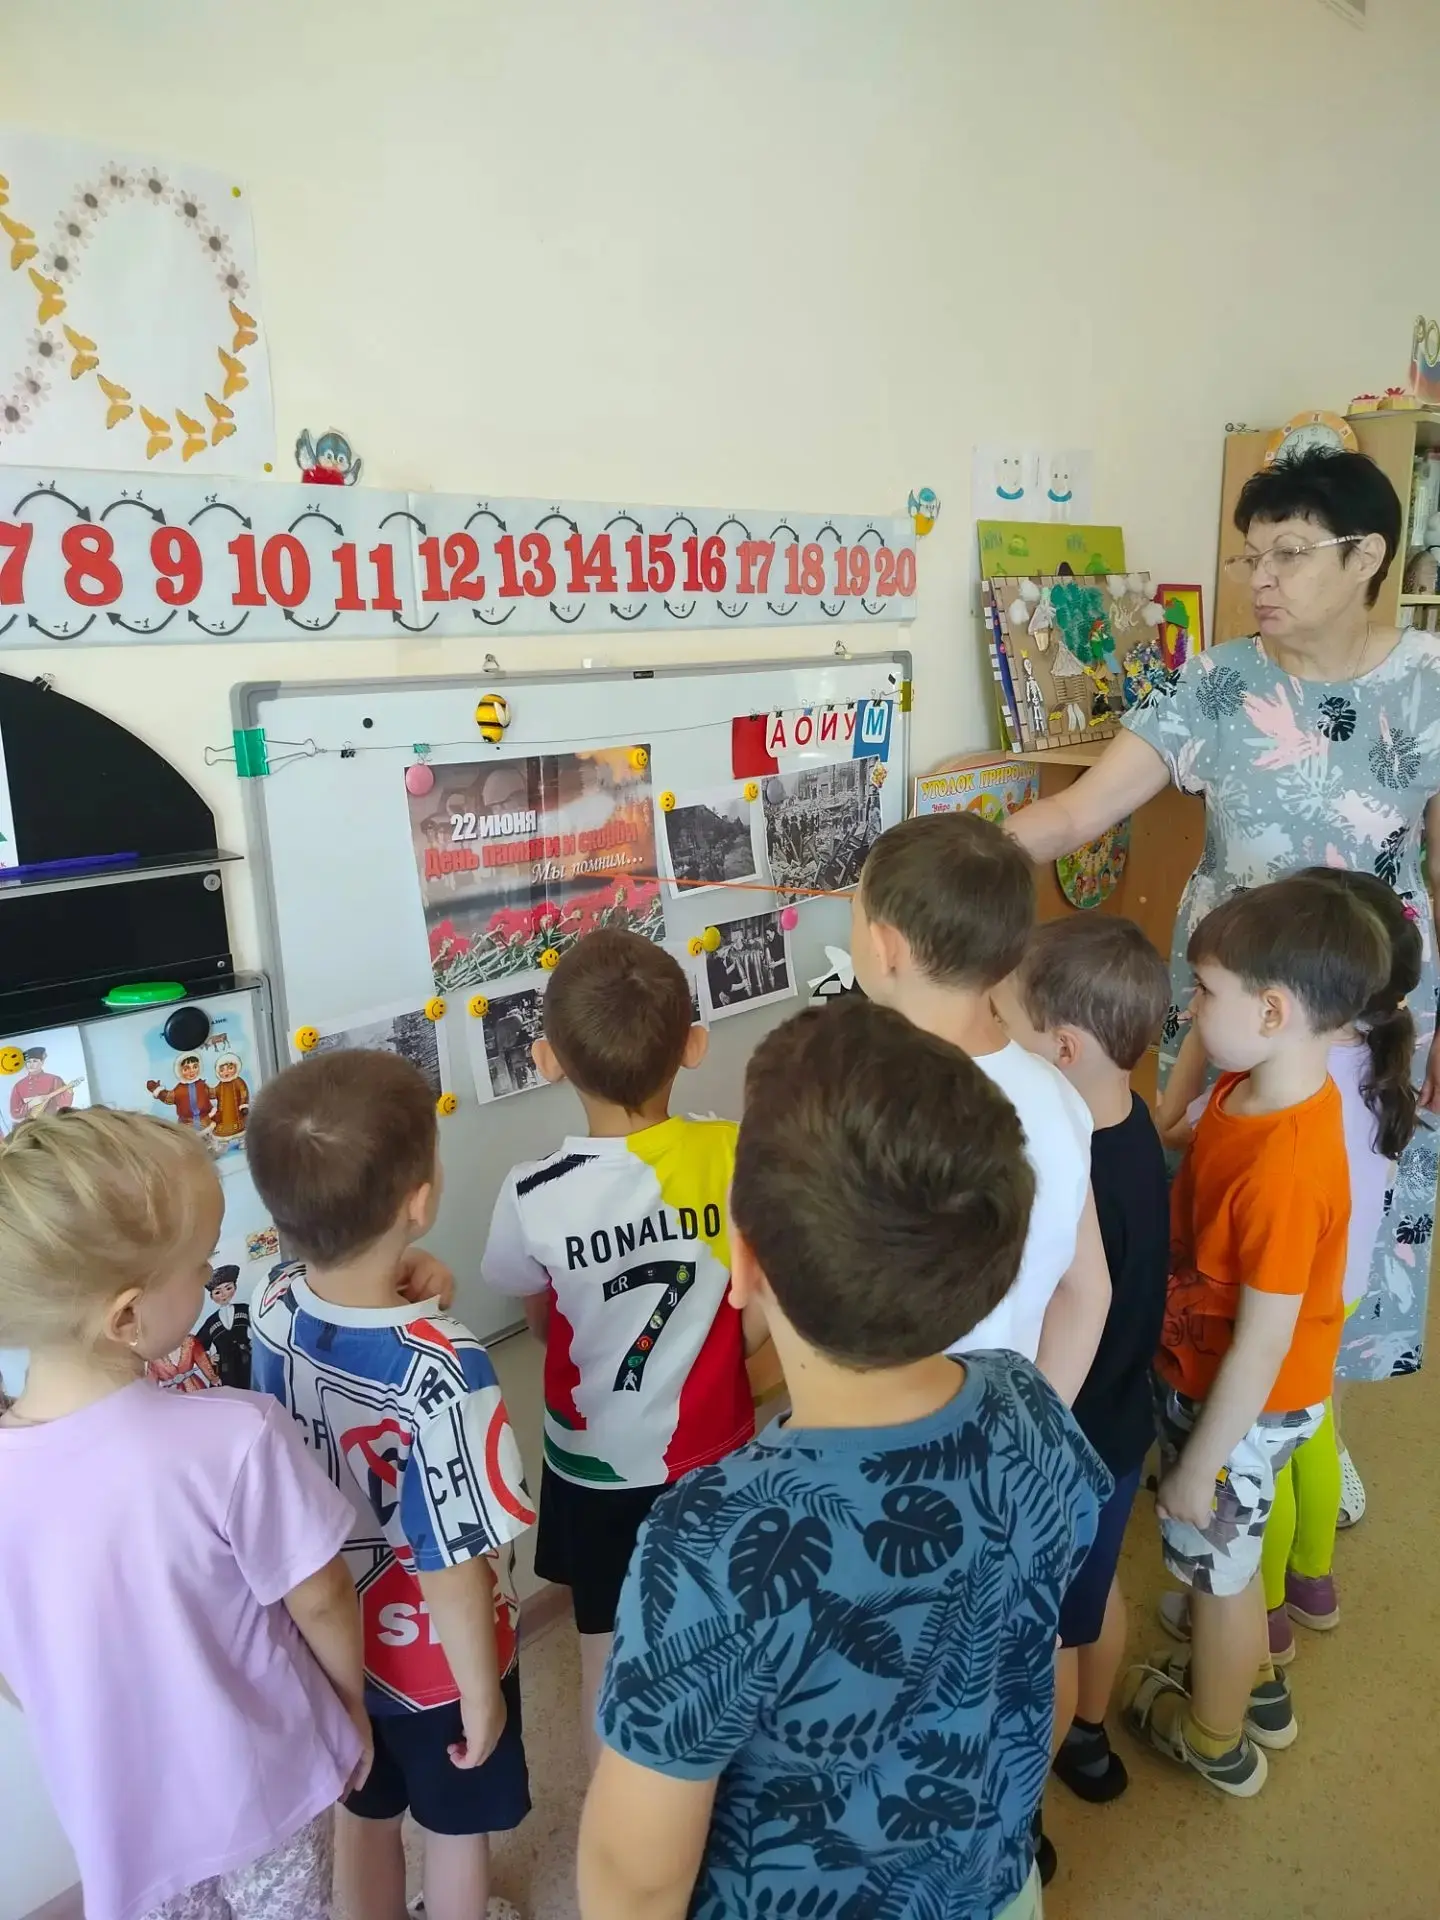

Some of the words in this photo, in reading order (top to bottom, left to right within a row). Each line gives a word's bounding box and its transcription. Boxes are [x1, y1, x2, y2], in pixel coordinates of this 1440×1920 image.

[0, 521, 33, 605] 7
[61, 523, 123, 606] 8
[150, 526, 203, 606] 9
[228, 533, 310, 608] 10
[332, 543, 402, 612] 11
[418, 532, 485, 602] 12
[494, 533, 556, 597] 13
[564, 533, 618, 593] 14
[624, 533, 675, 593] 15
[682, 535, 726, 593] 16
[736, 540, 775, 594] 17
[784, 543, 825, 595] 18
[834, 546, 870, 595] 19
[874, 548, 917, 597] 20
[921, 773, 975, 801] УГОЛОК
[450, 812, 478, 842] 22
[424, 847, 480, 882] День
[482, 834, 561, 869] памяти
[563, 830, 576, 857] и
[578, 820, 639, 853] скорби
[531, 861, 566, 884] Мы
[565, 1203, 721, 1271] RONALDO
[611, 1275, 629, 1295] CR
[602, 1260, 697, 1392] 7
